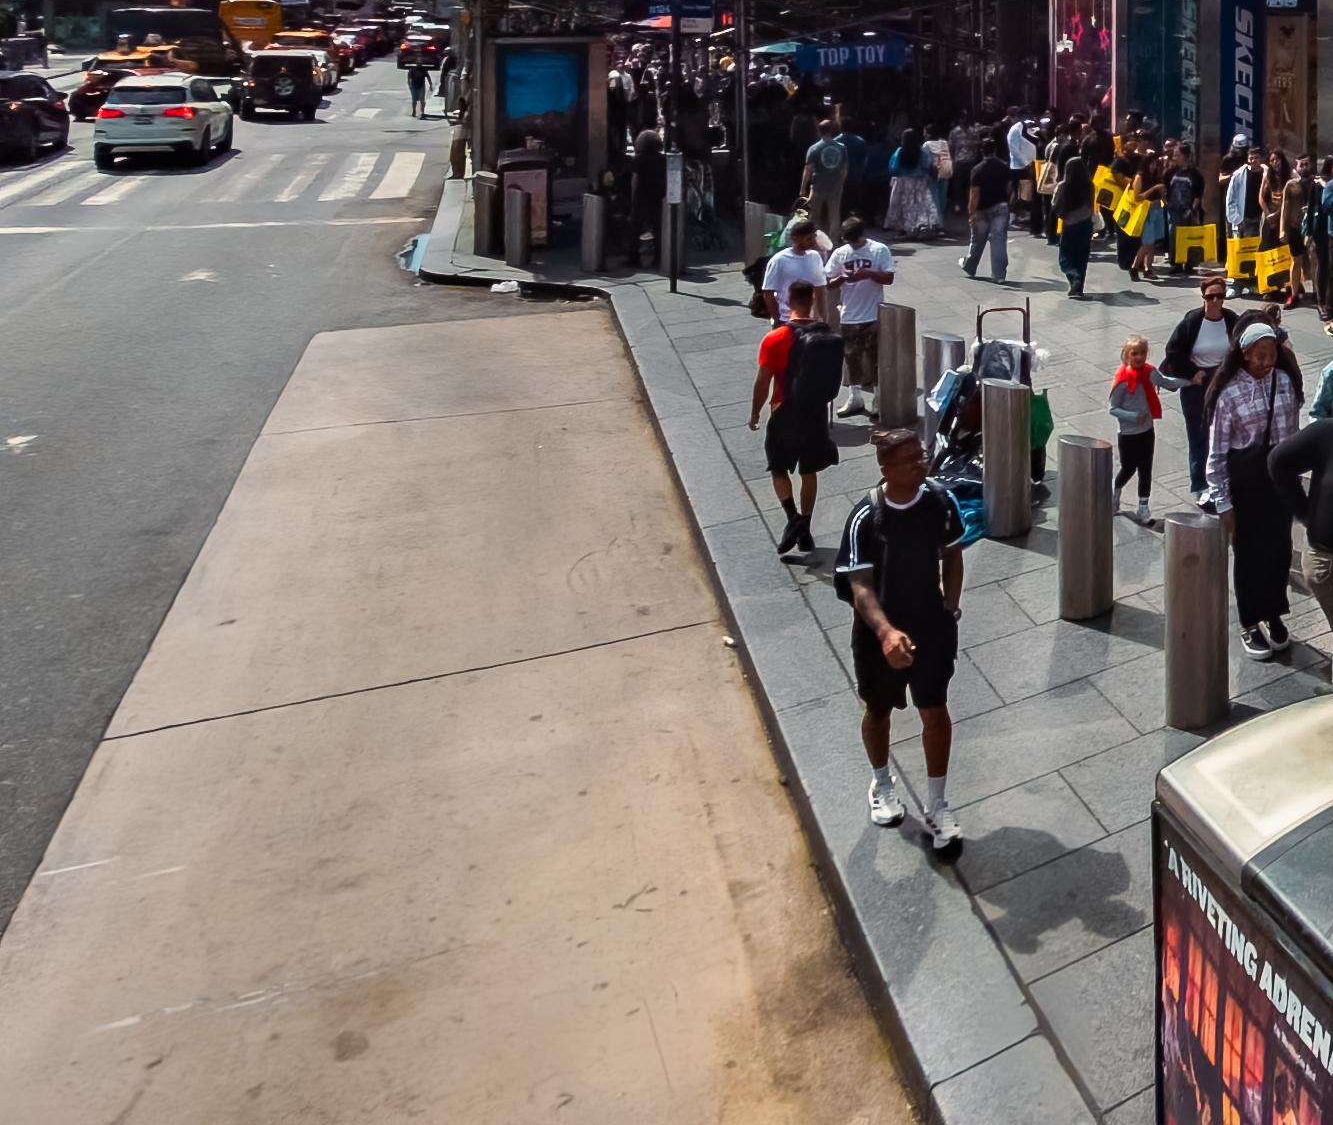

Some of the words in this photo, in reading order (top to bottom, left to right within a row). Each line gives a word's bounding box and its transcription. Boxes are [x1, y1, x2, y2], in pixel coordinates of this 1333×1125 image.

[817, 48, 849, 66] TOP
[854, 46, 886, 65] TOY
[1180, 854, 1258, 982] RIVETING
